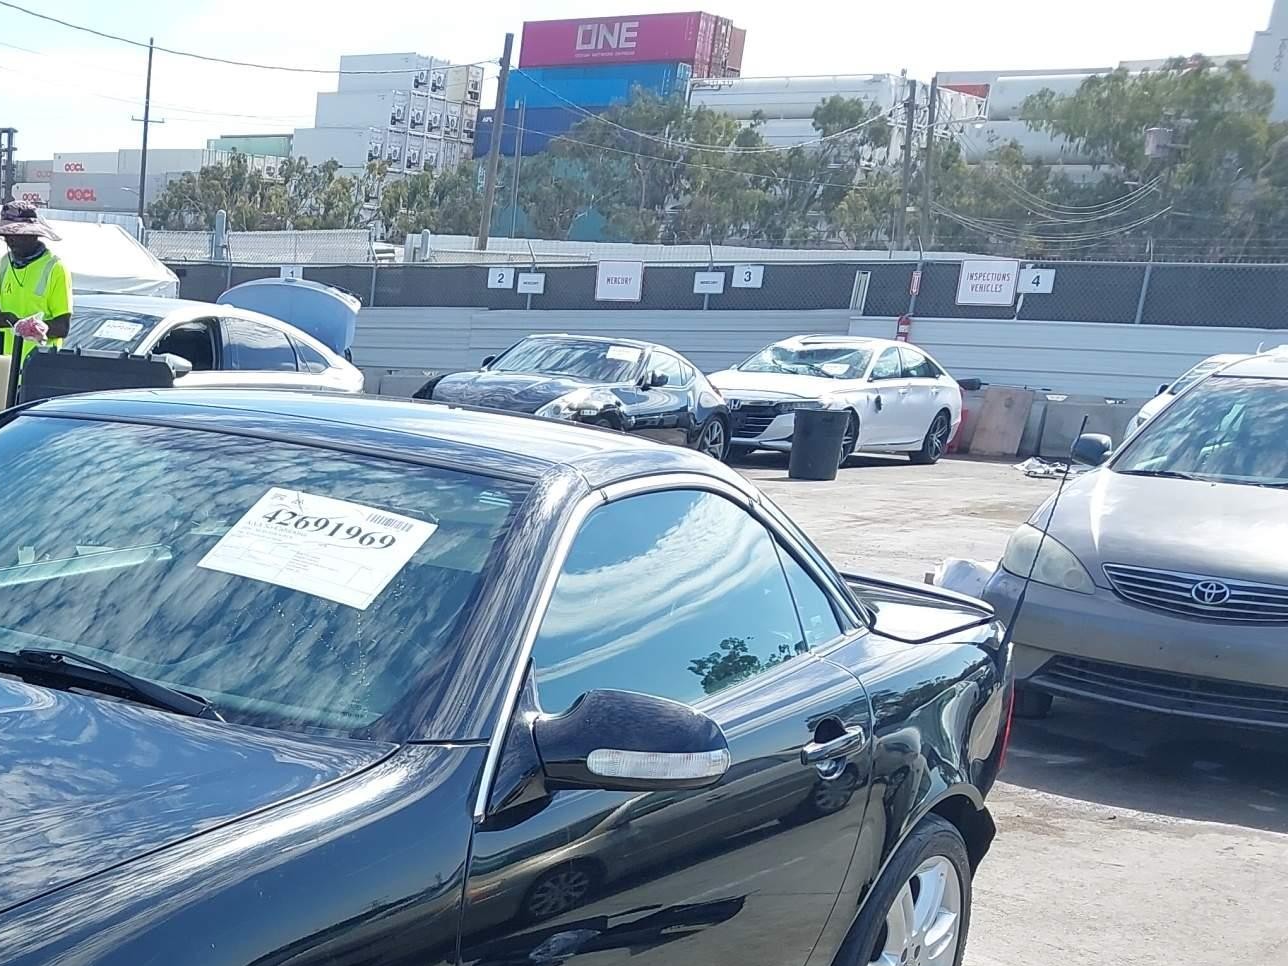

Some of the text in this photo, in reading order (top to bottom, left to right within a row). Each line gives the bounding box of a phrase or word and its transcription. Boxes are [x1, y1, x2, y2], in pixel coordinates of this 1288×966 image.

[576, 21, 639, 50] ONE
[65, 163, 84, 172] OOCL
[37, 170, 53, 178] OOC
[22, 193, 41, 201] OOCL
[67, 188, 96, 201] OOCL
[497, 273, 505, 283] 2
[606, 277, 632, 285] MERCURY
[743, 271, 752, 282] 3
[966, 272, 1011, 281] INSPECTIONS
[1031, 275, 1041, 287] 4
[970, 284, 1002, 293] VEHICLES
[262, 508, 396, 549] 42691969
